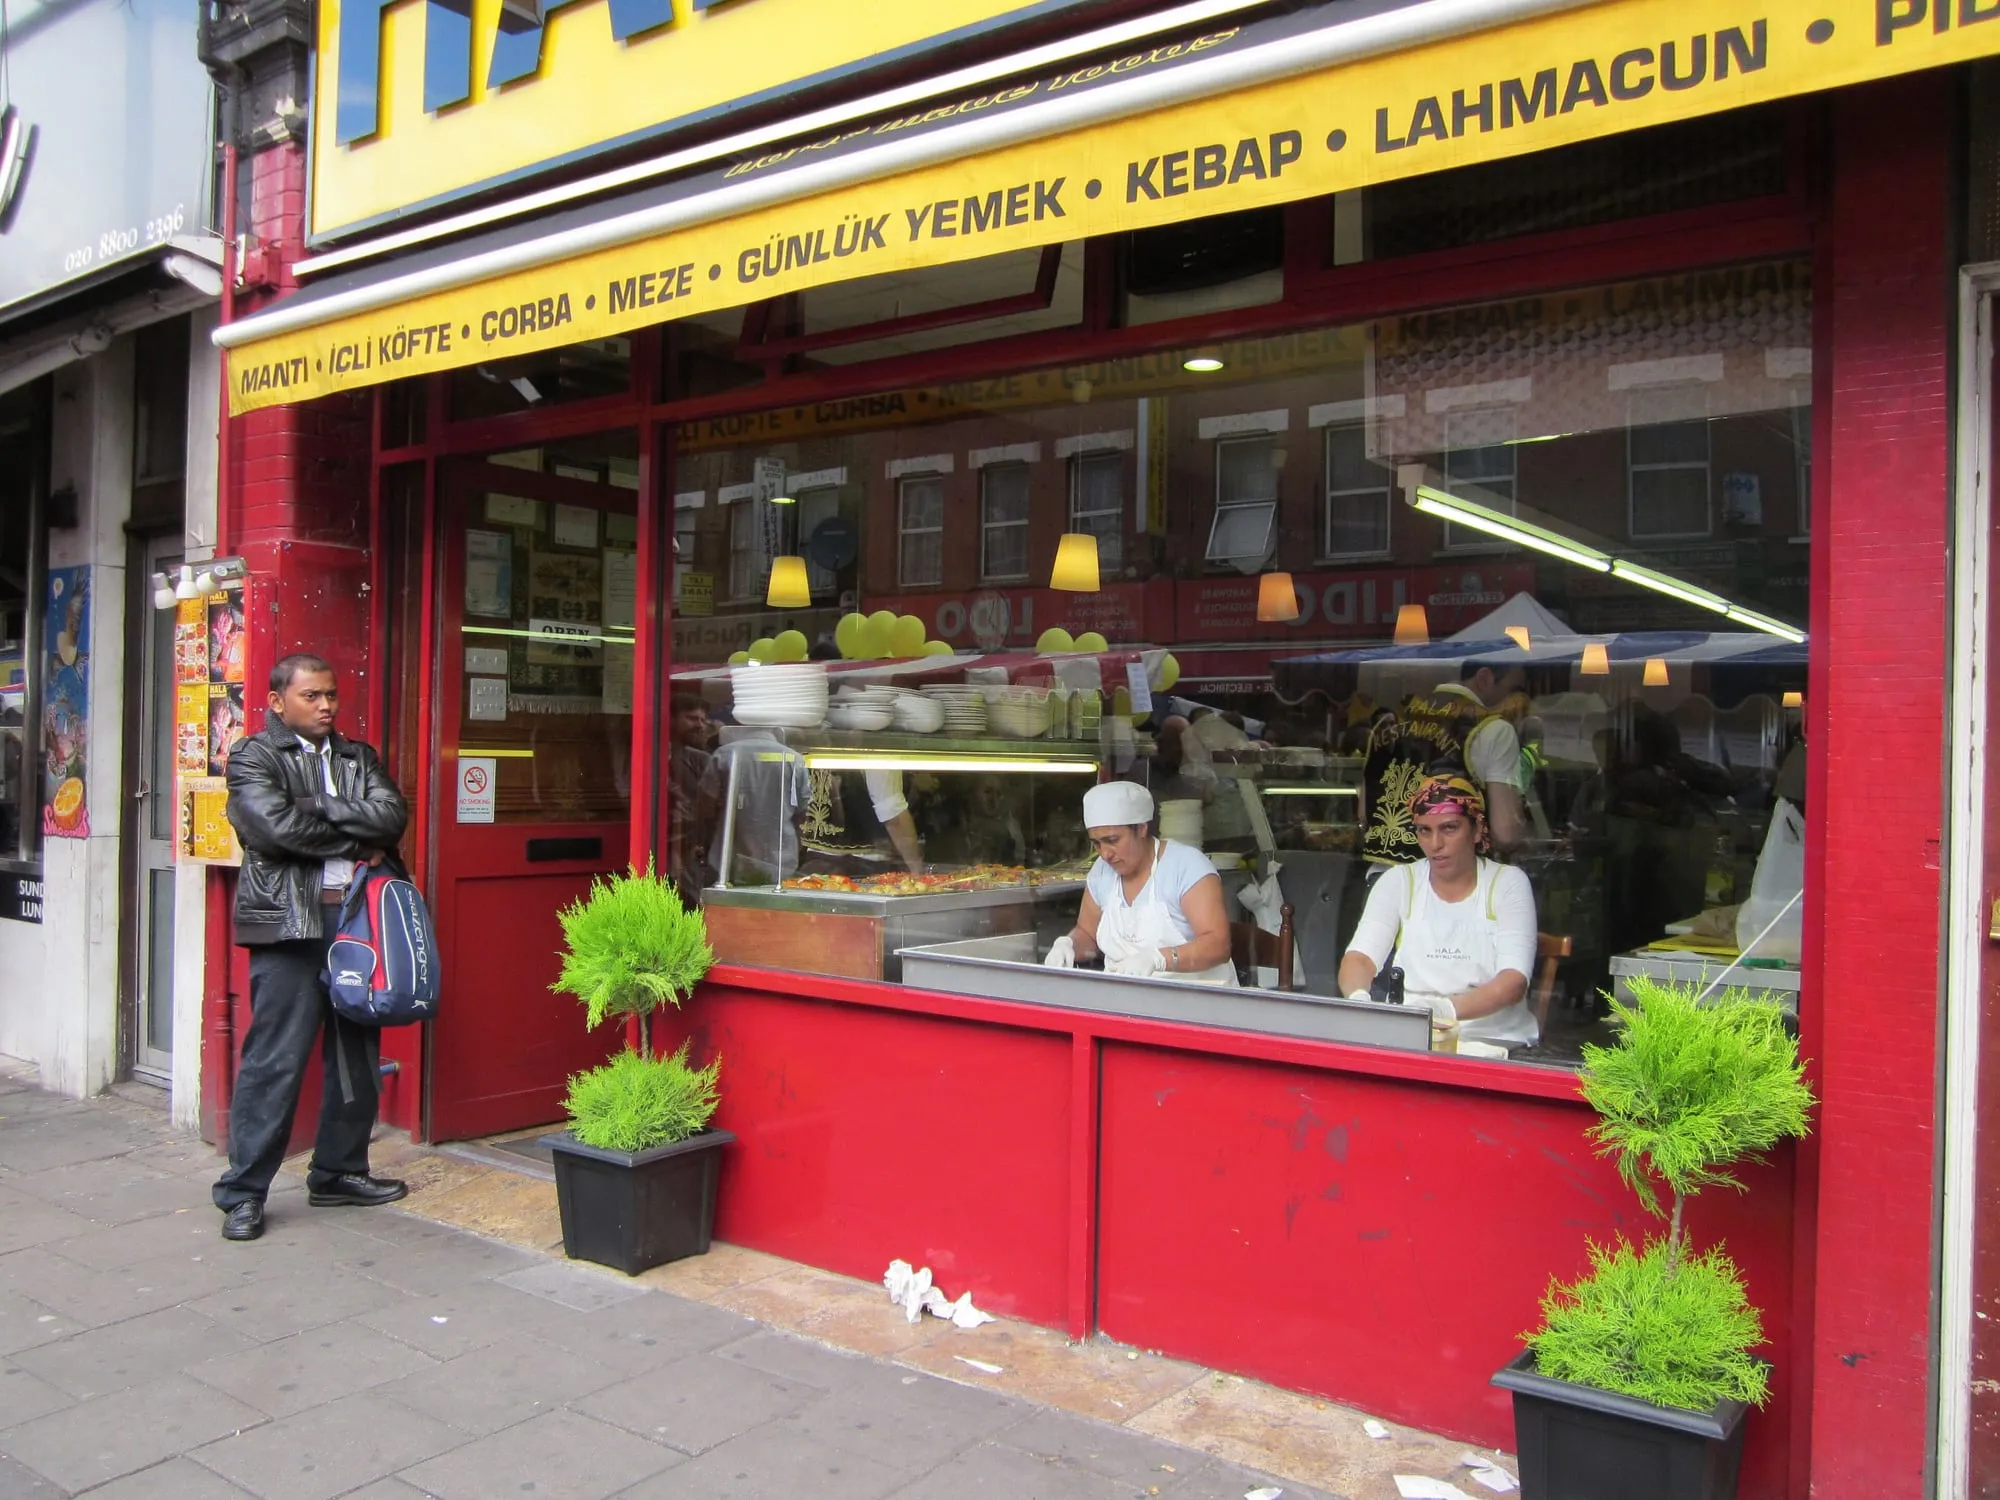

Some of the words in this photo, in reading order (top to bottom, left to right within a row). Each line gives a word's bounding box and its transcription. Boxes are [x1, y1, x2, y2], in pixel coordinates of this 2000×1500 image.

[1375, 18, 1768, 154] LAHMACUN
[1126, 129, 1303, 203] KEBAP
[65, 246, 92, 272] 020
[99, 228, 138, 260] 8800
[737, 213, 891, 284] GÜNLÜK
[905, 177, 1067, 242] YEMEK
[609, 263, 695, 315] MEZE
[379, 323, 452, 366] KÖFTE
[241, 356, 309, 395] MANTI
[542, 625, 590, 642] OPEN
[1373, 720, 1461, 756] RESTAURANT
[22, 901, 43, 919] LUN
